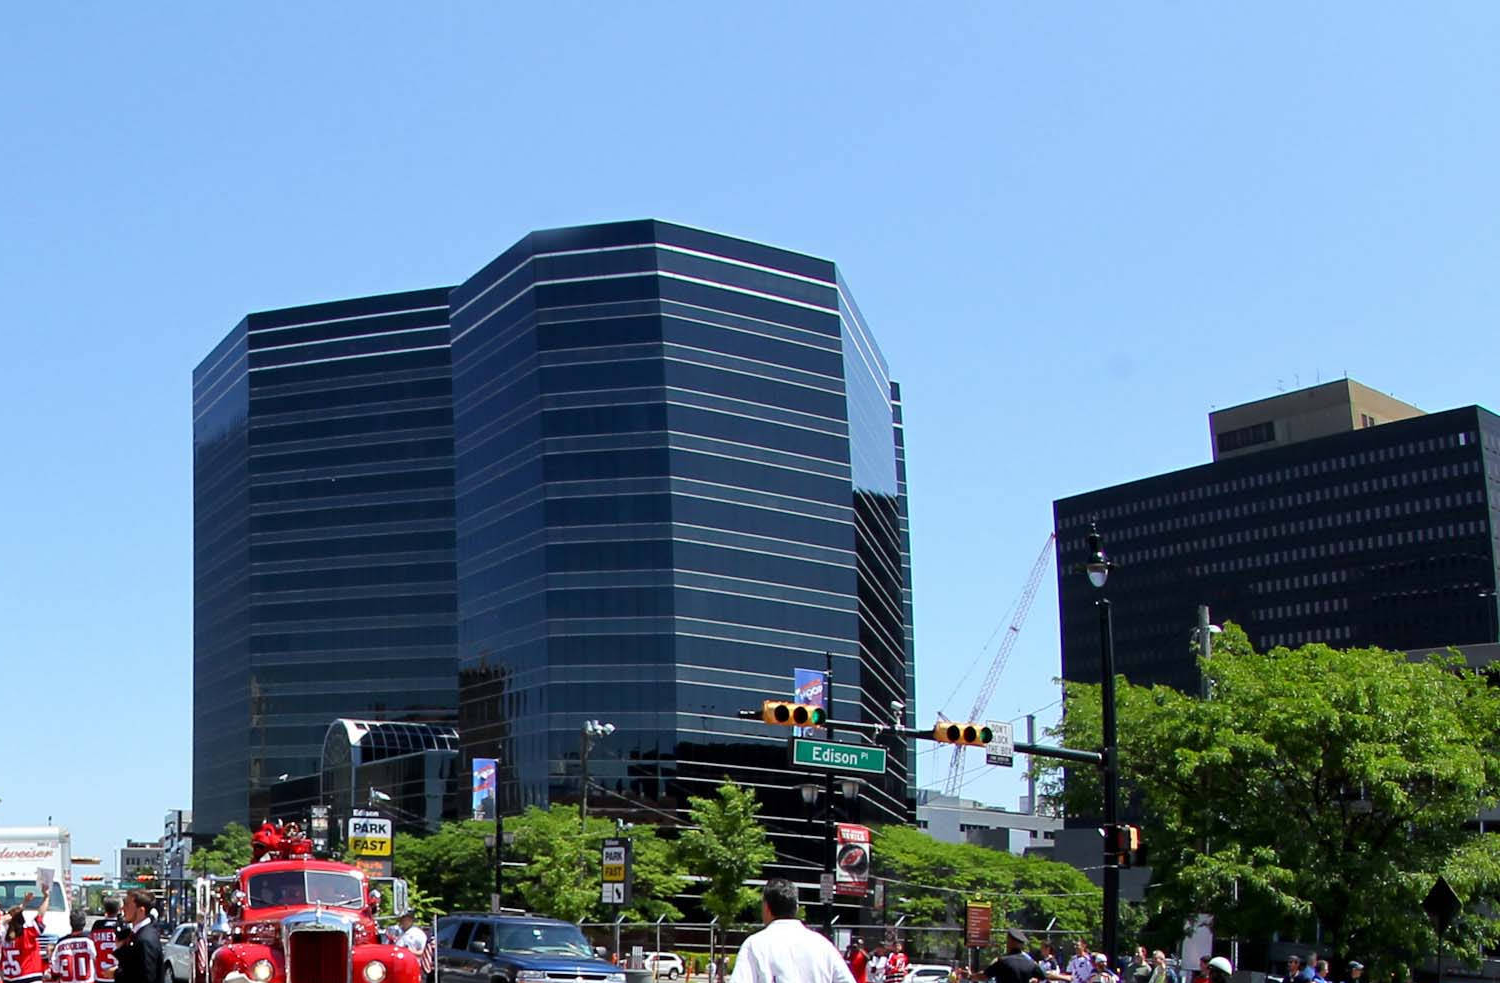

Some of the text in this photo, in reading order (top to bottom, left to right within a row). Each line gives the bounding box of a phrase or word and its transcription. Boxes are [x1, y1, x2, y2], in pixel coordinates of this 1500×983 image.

[812, 746, 869, 765] Edison Pl
[353, 823, 387, 834] PARK
[353, 840, 387, 851] FAST
[605, 851, 623, 861] PARK
[59, 953, 92, 982] 30
